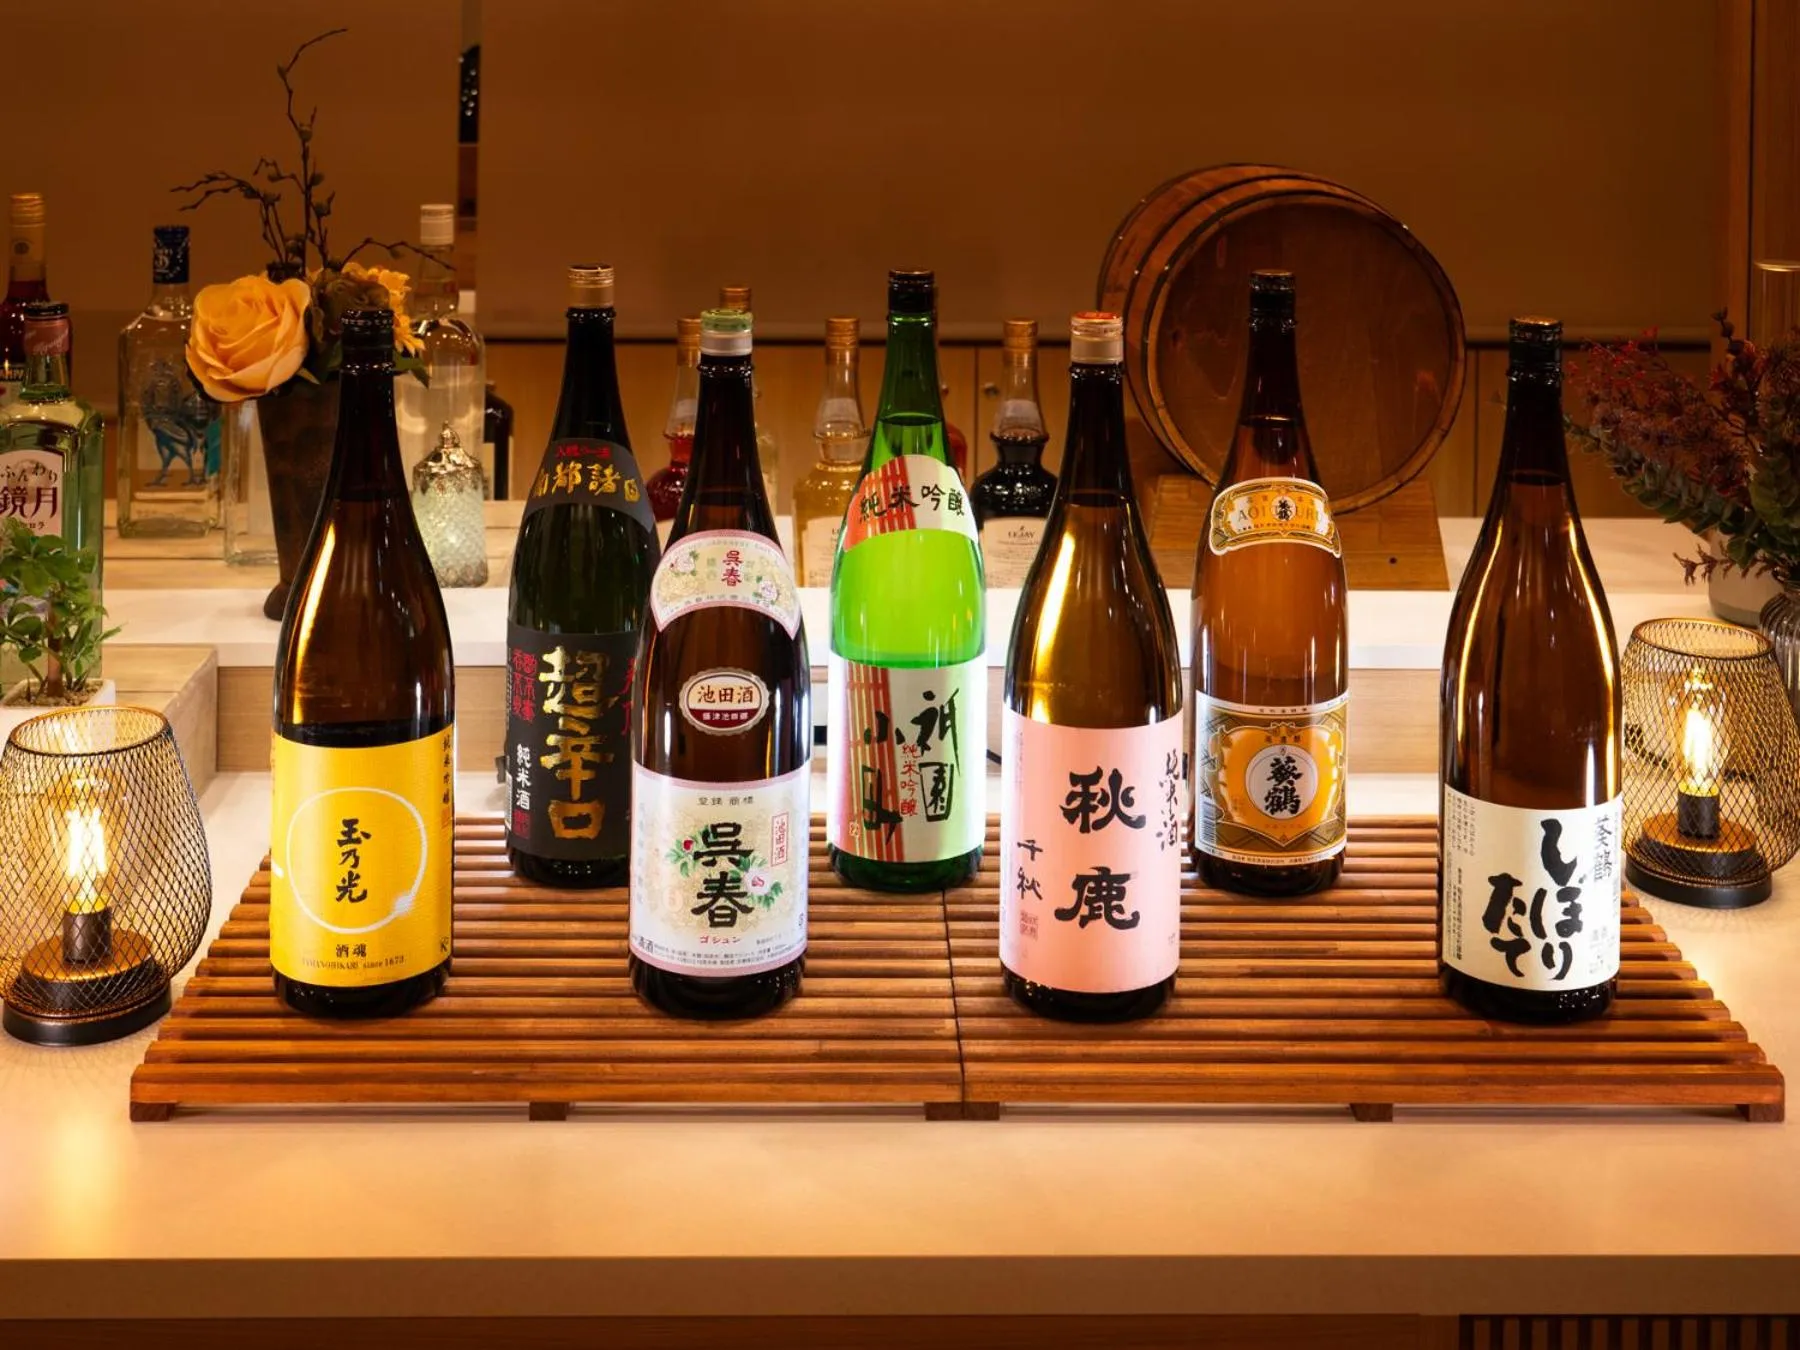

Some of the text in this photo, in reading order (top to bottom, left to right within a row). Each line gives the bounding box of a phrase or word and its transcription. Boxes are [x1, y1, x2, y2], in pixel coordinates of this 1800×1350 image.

[0, 486, 57, 519] 鏡月
[697, 684, 754, 704] 池田酒
[516, 743, 532, 812] 純米酒
[538, 645, 620, 840] 超辛口
[335, 818, 372, 903] 玉乃光
[690, 822, 755, 928] 呉春
[1016, 839, 1044, 901] 千秋
[1053, 766, 1147, 931] 秋鹿
[1529, 818, 1583, 981] しぼり
[335, 943, 367, 958] 酒魂
